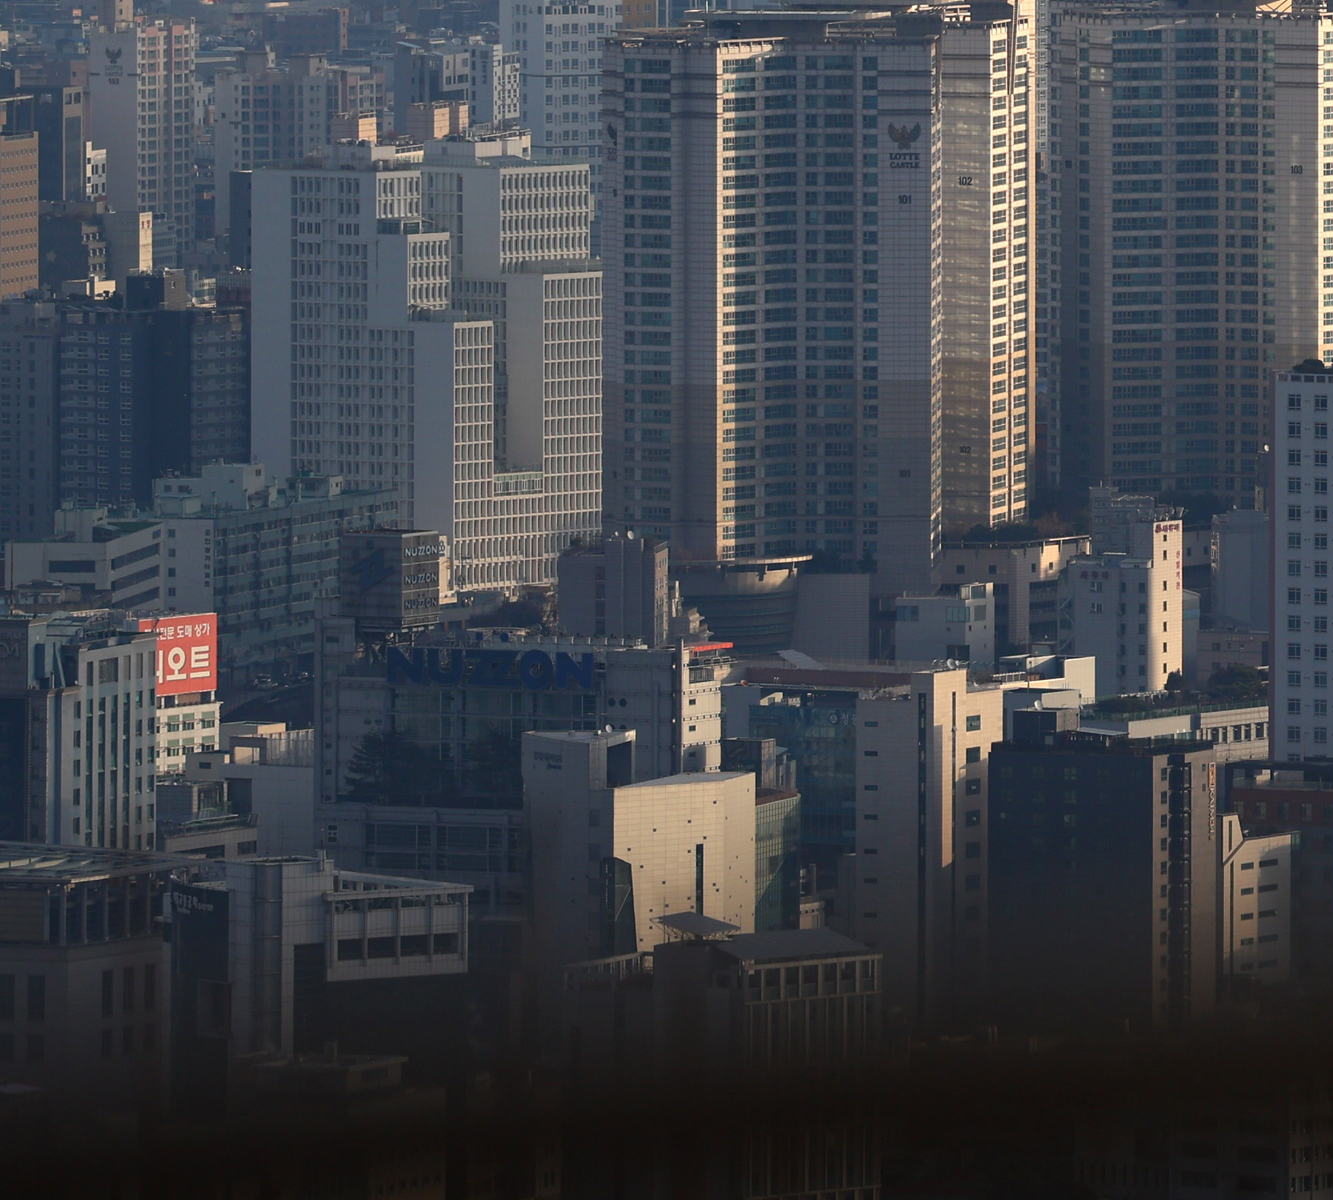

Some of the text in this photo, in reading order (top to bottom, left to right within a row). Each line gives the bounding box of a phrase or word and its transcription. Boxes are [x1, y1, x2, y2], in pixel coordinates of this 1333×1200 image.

[889, 152, 920, 161] LOTTE
[889, 161, 920, 169] CASTLE
[1290, 164, 1303, 175] 103
[958, 176, 973, 186] 102
[898, 195, 912, 205] 101
[405, 544, 438, 558] NUZZON
[405, 573, 438, 586] NUZZON
[405, 597, 438, 611] NUZZON
[176, 625, 193, 638] 도매
[194, 623, 210, 637] 상가
[385, 645, 594, 689] NUZZON
